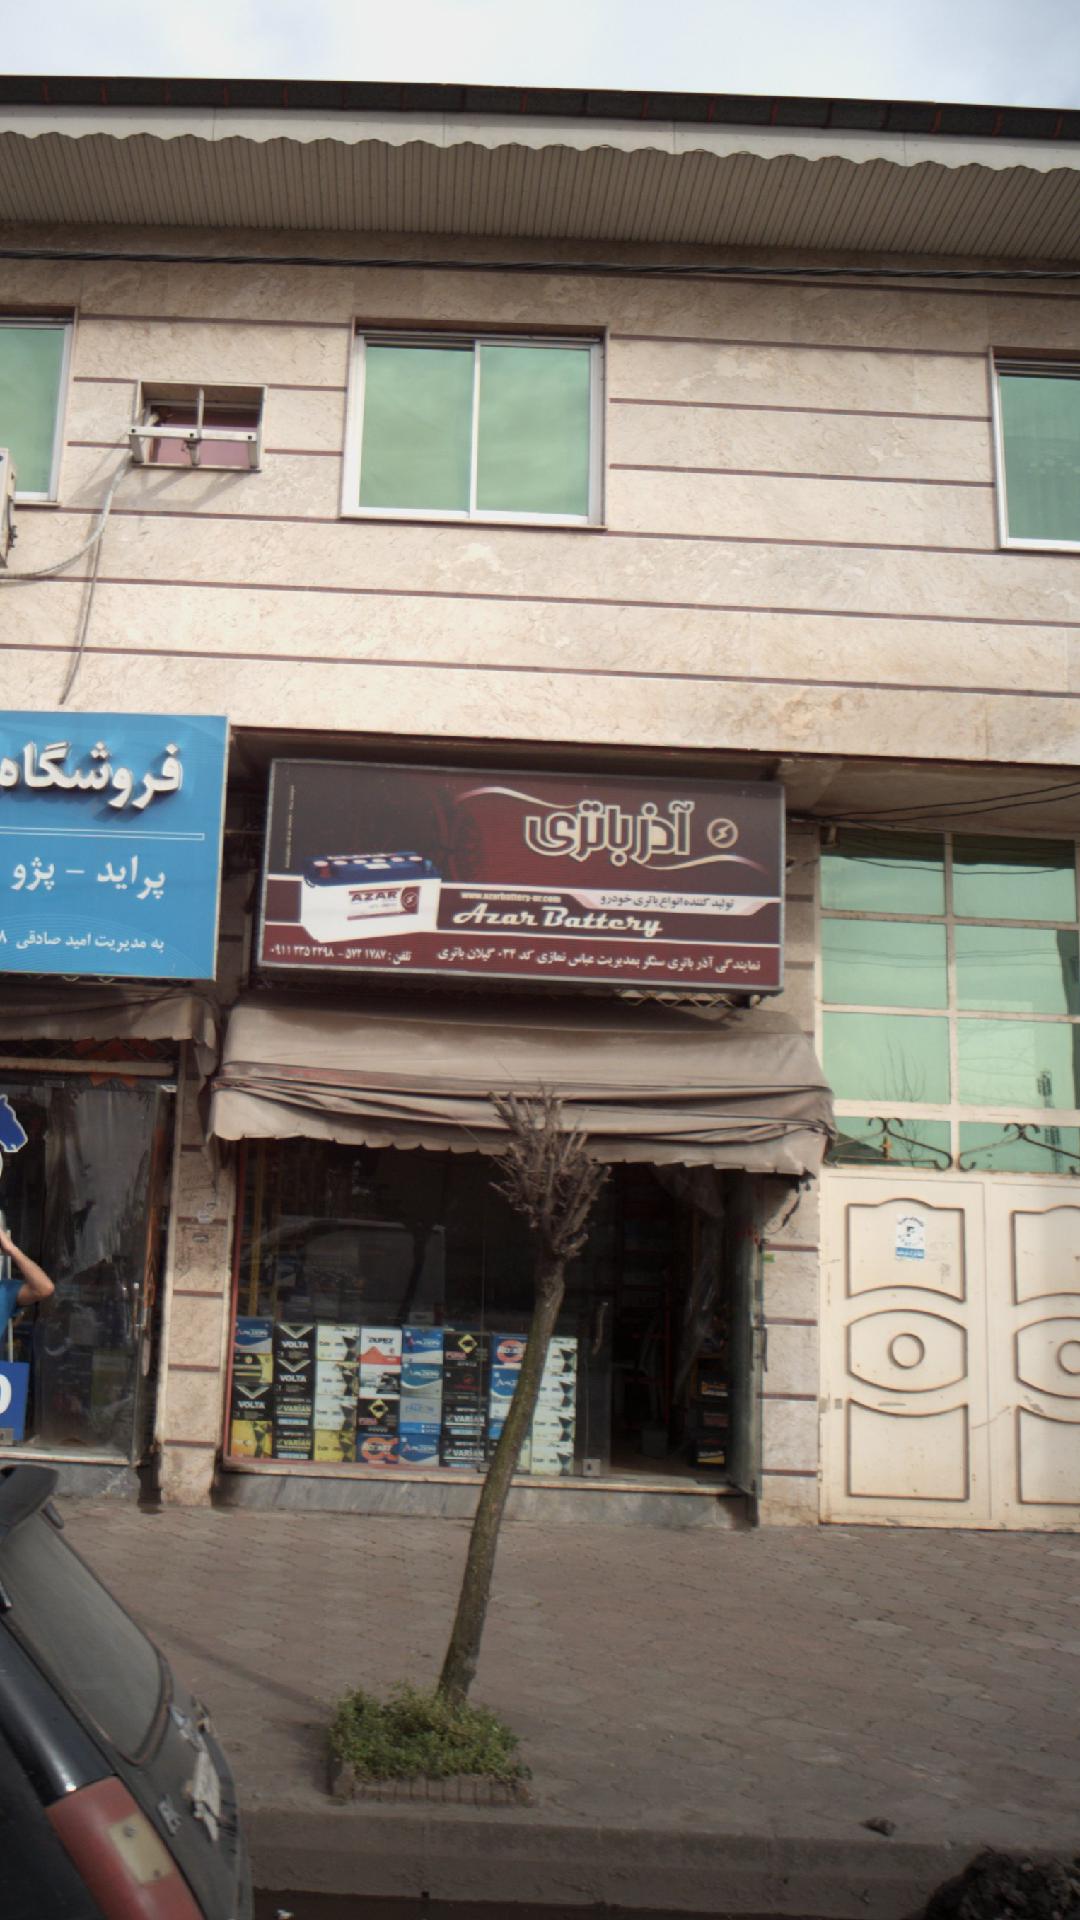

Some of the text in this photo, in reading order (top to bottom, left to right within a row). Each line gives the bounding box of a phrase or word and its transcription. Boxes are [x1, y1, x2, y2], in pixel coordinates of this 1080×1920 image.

[0, 740, 184, 809] فروشگاه
[11, 857, 56, 891] پژو
[97, 854, 167, 900] پراید
[351, 891, 398, 902] AZAR
[600, 893, 735, 911] تولید کننده انواع باتری خودرو
[453, 903, 664, 937] Azar Battery
[15, 929, 62, 949] صادقی
[65, 932, 92, 949] امید
[95, 935, 147, 954] مدیریت
[150, 937, 165, 953] به
[437, 946, 466, 961] باتری
[466, 948, 496, 962] گیلان
[518, 949, 535, 961] کد
[567, 954, 595, 967] عباس
[641, 955, 666, 971] سنگر
[666, 957, 695, 972] باتری
[696, 956, 714, 971] آذر
[715, 959, 761, 974] نمایندگی
[281, 1340, 309, 1349] VOLTA
[279, 1374, 307, 1383] VOLTA
[237, 1400, 266, 1409] VOLTA
